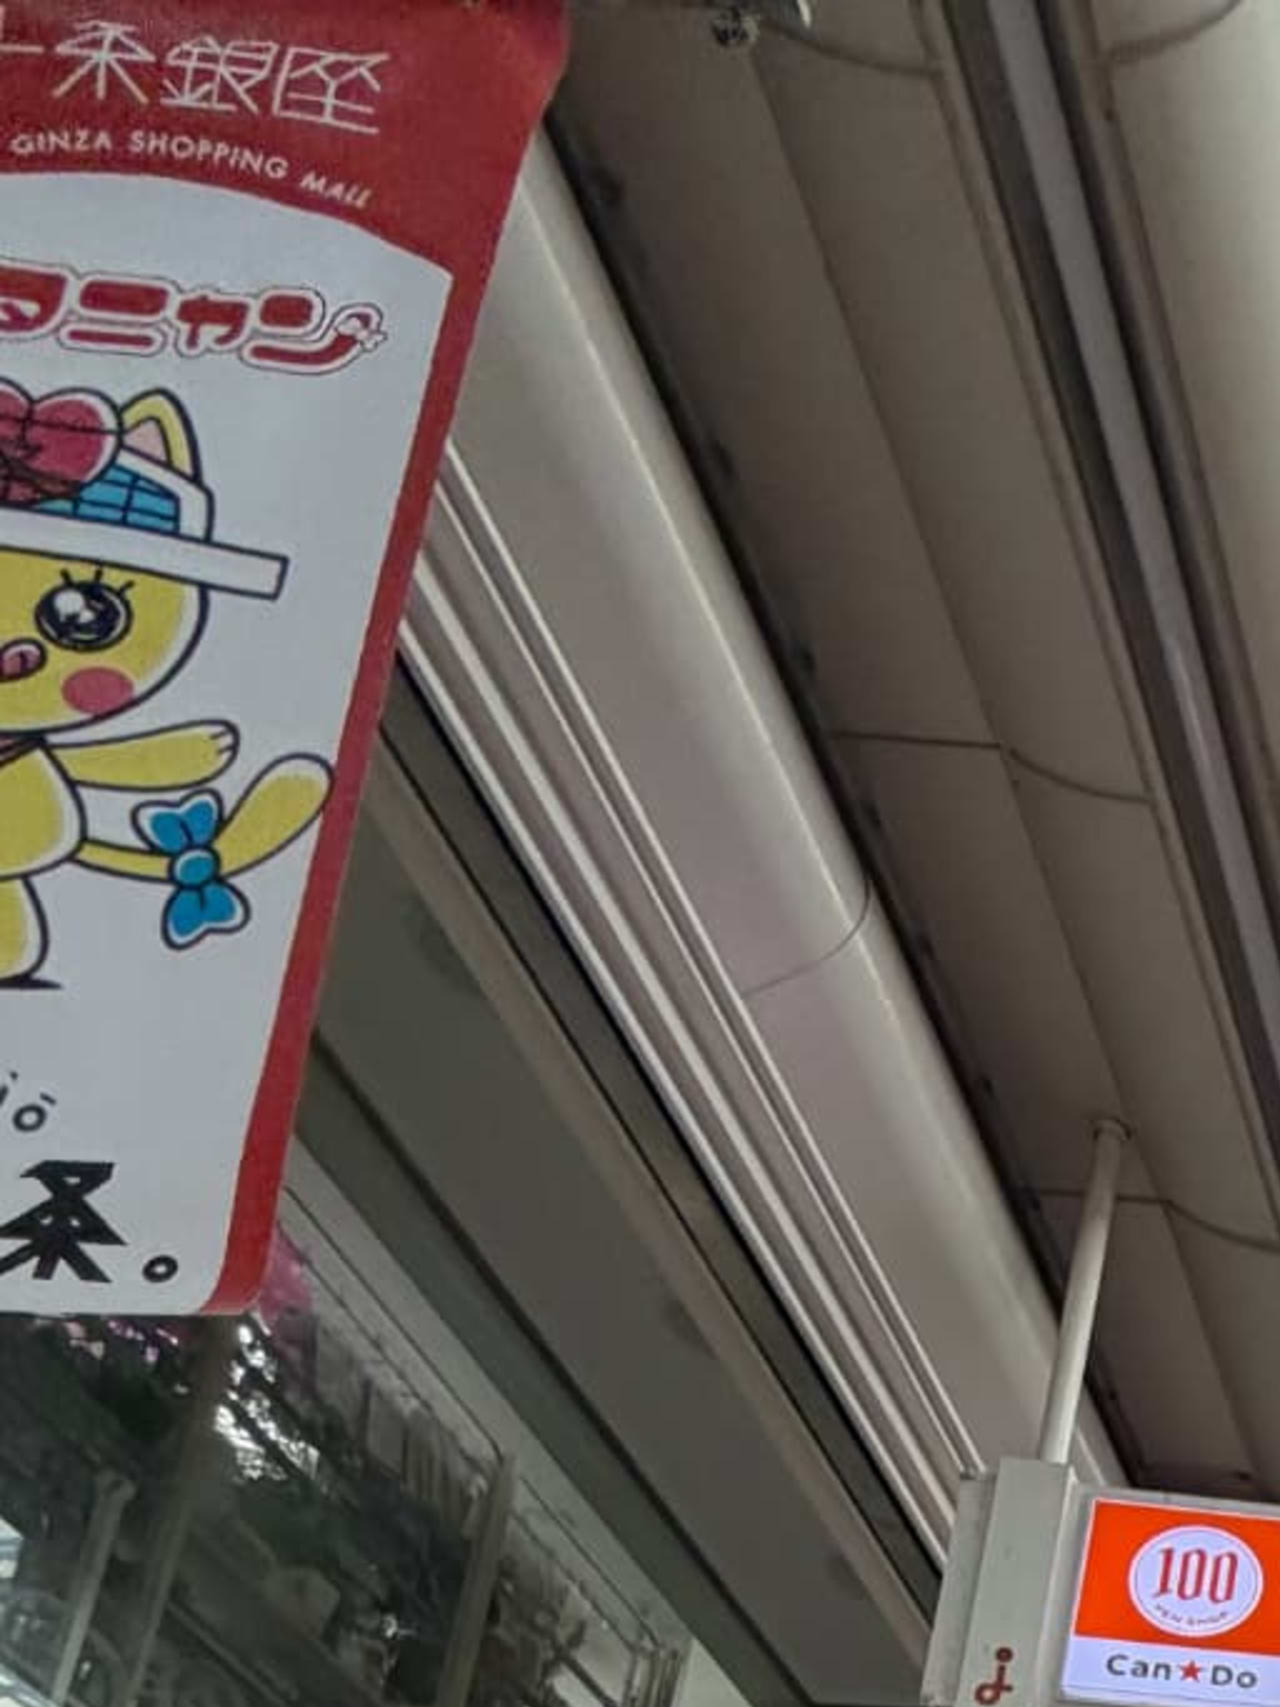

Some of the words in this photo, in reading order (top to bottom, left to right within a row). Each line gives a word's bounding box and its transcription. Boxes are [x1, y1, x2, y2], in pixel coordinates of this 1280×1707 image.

[10, 129, 113, 154] GINZA
[129, 130, 290, 180] SHOPPING
[300, 172, 373, 208] MALL
[1154, 1546, 1239, 1604] 100
[1106, 1653, 1172, 1682] Can
[1211, 1664, 1258, 1690] Do
